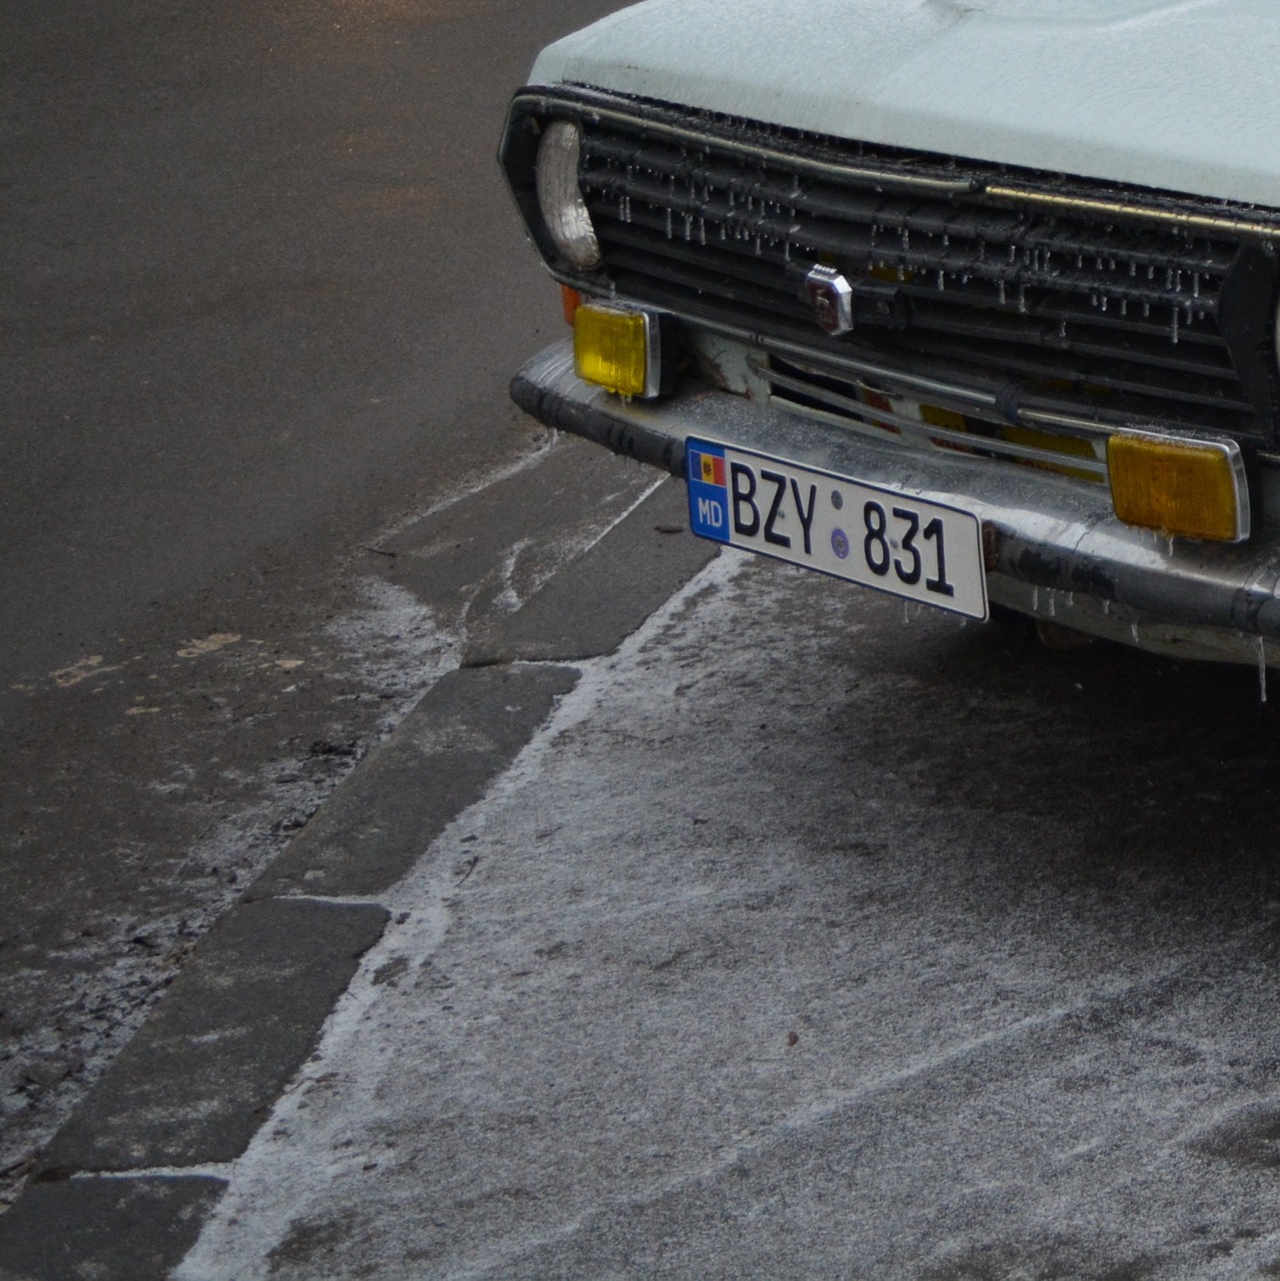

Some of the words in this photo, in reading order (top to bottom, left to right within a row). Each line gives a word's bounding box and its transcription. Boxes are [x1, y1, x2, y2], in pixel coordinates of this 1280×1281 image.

[698, 497, 723, 528] MD
[730, 461, 817, 555] BZY
[863, 500, 955, 597] 831
